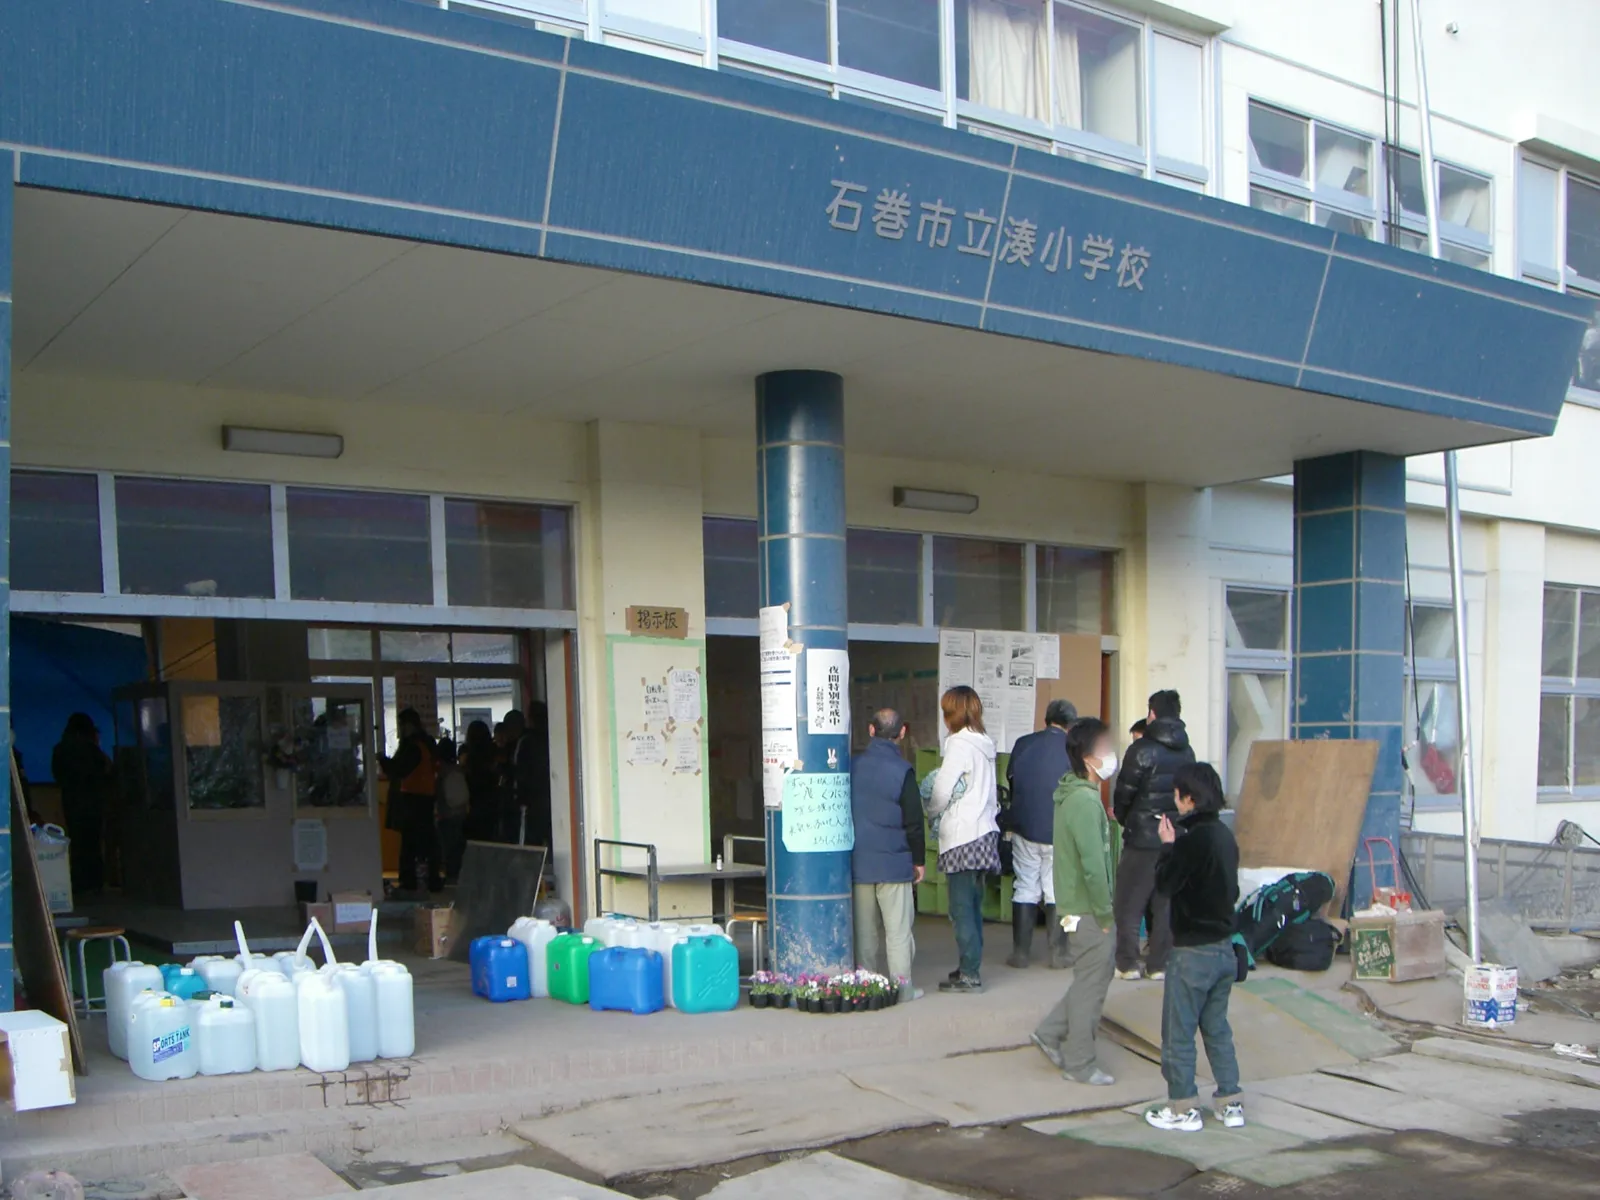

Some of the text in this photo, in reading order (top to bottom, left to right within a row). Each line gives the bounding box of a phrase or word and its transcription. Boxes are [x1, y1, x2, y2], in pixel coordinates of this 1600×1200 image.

[825, 179, 1151, 291] 石巻市立湊小学校
[637, 609, 678, 629] 掲示板
[153, 1027, 190, 1052] SPORTS TANK
